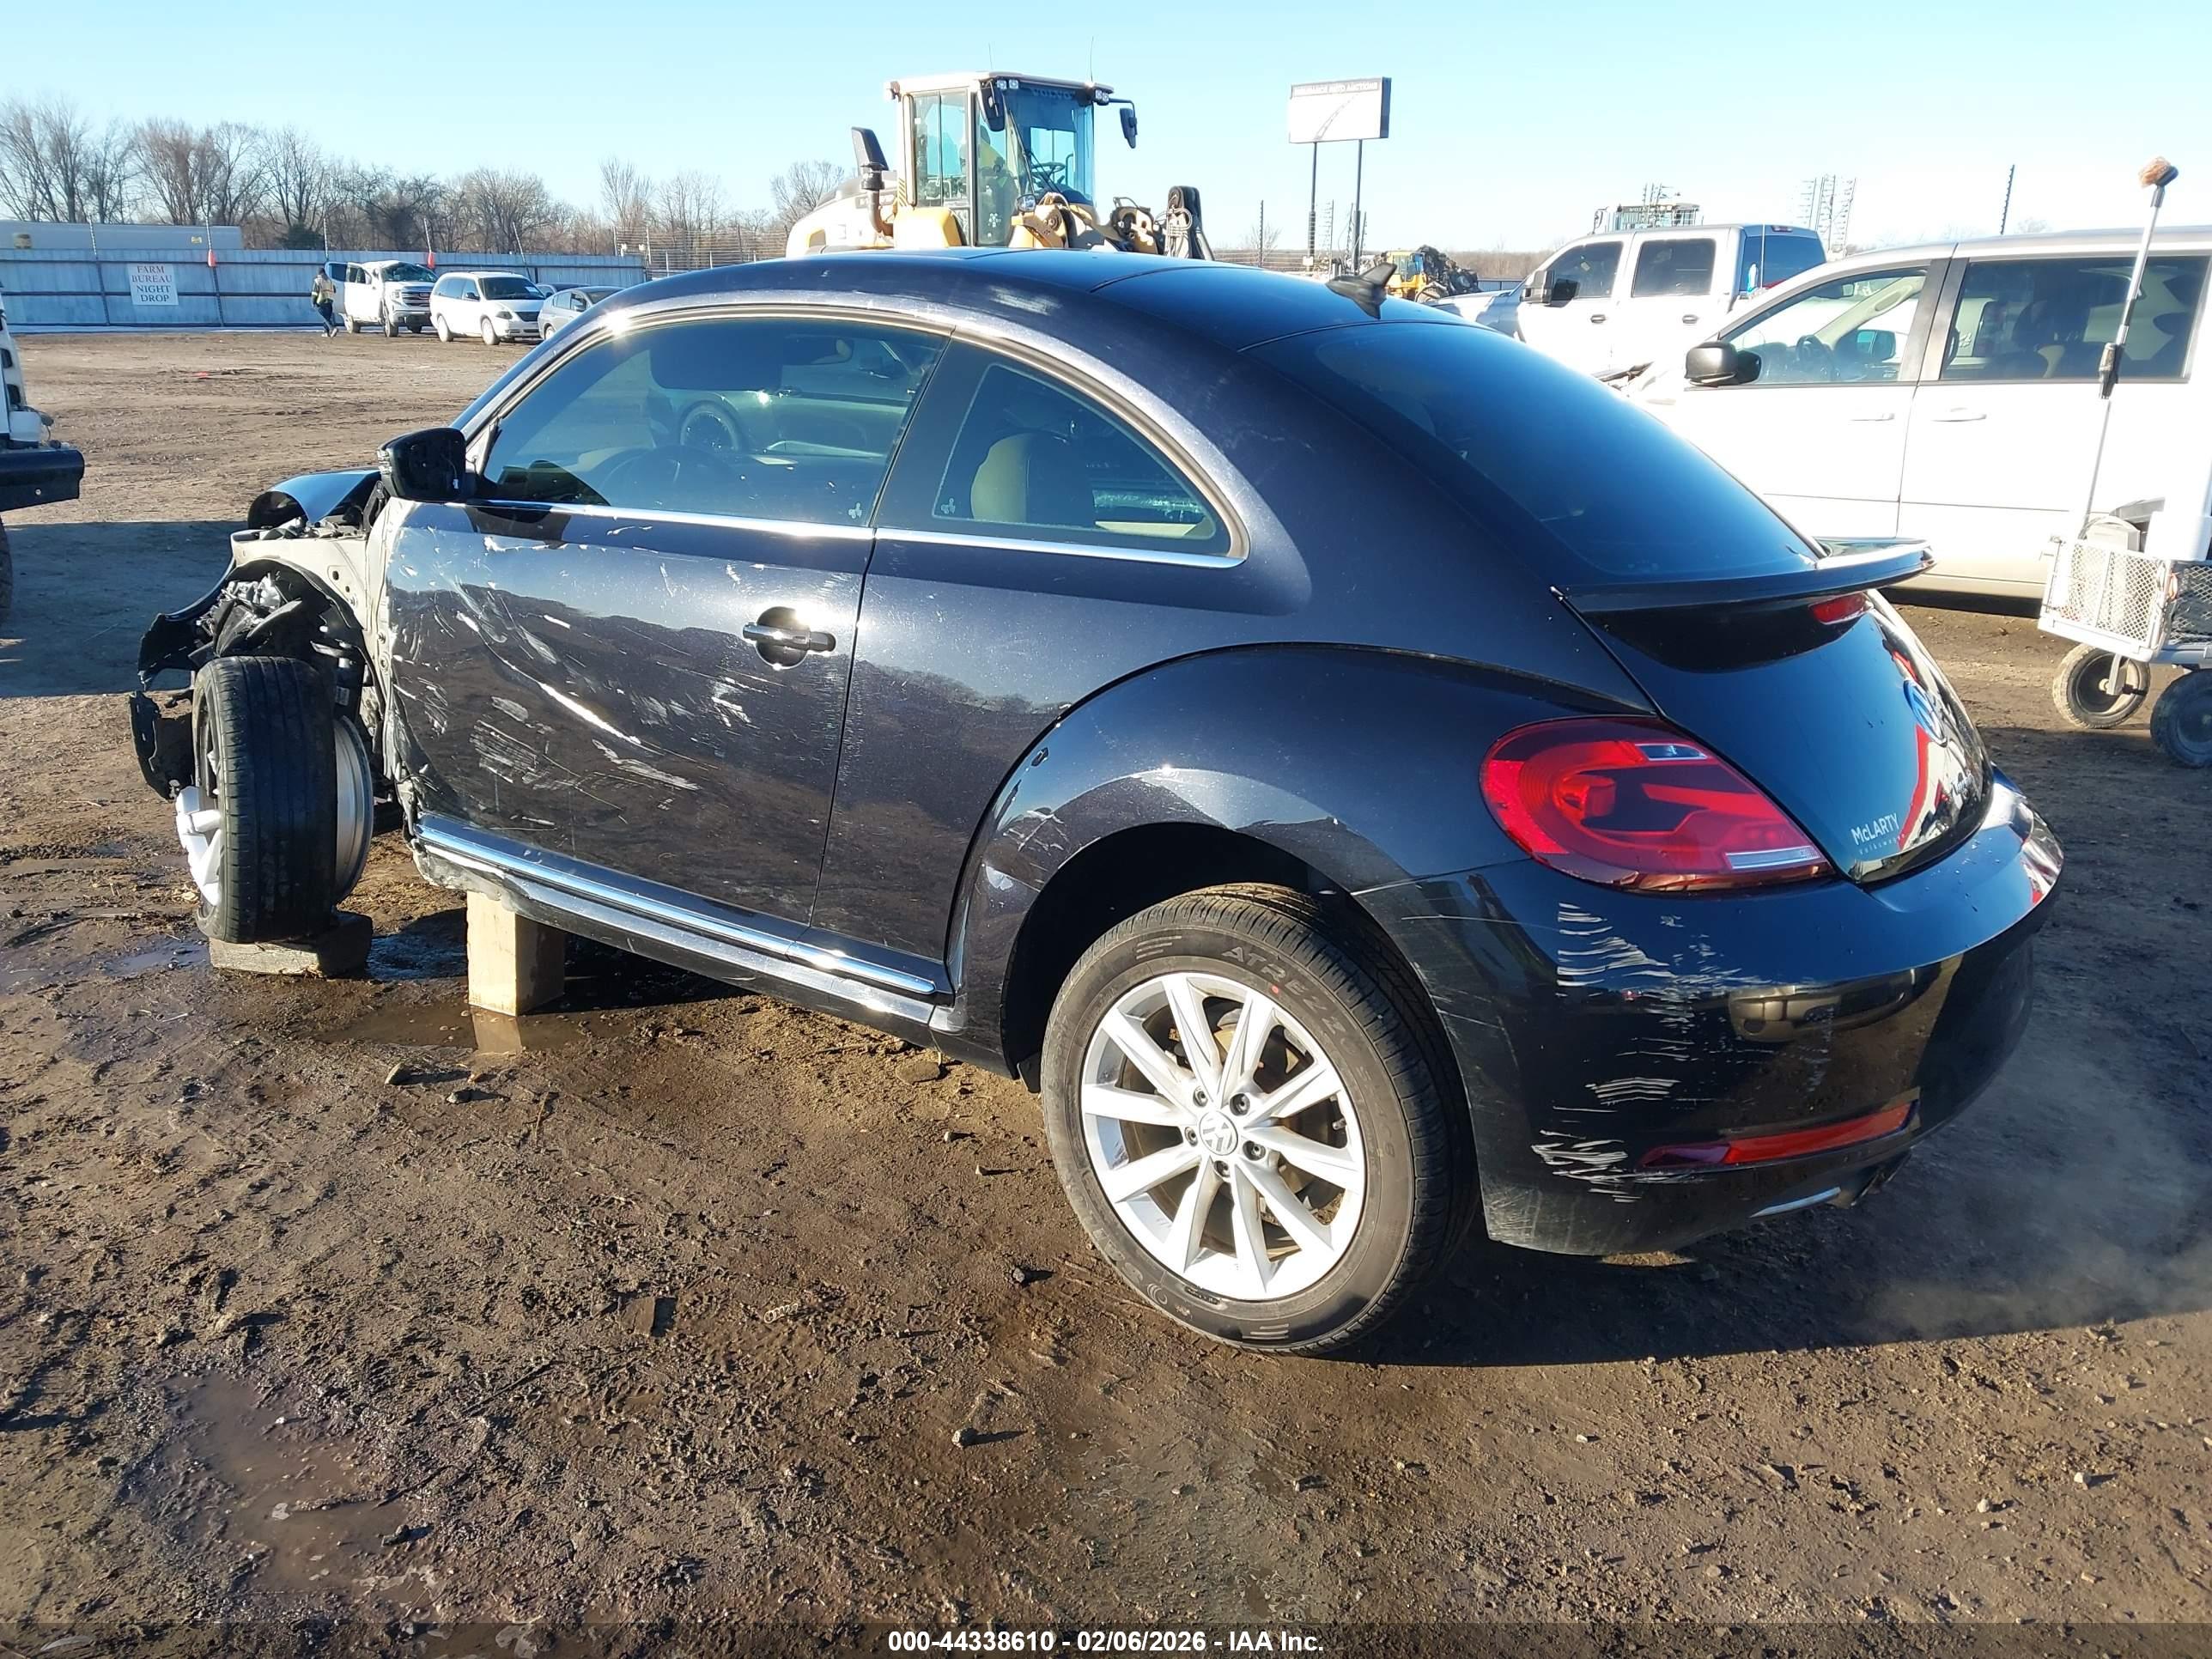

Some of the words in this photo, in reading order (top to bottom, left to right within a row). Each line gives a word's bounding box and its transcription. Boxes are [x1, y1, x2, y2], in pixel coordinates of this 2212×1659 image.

[137, 265, 165, 274] FARM
[1850, 812, 1899, 846] McLARTY
[1221, 945, 1357, 1056] ATREZZO
